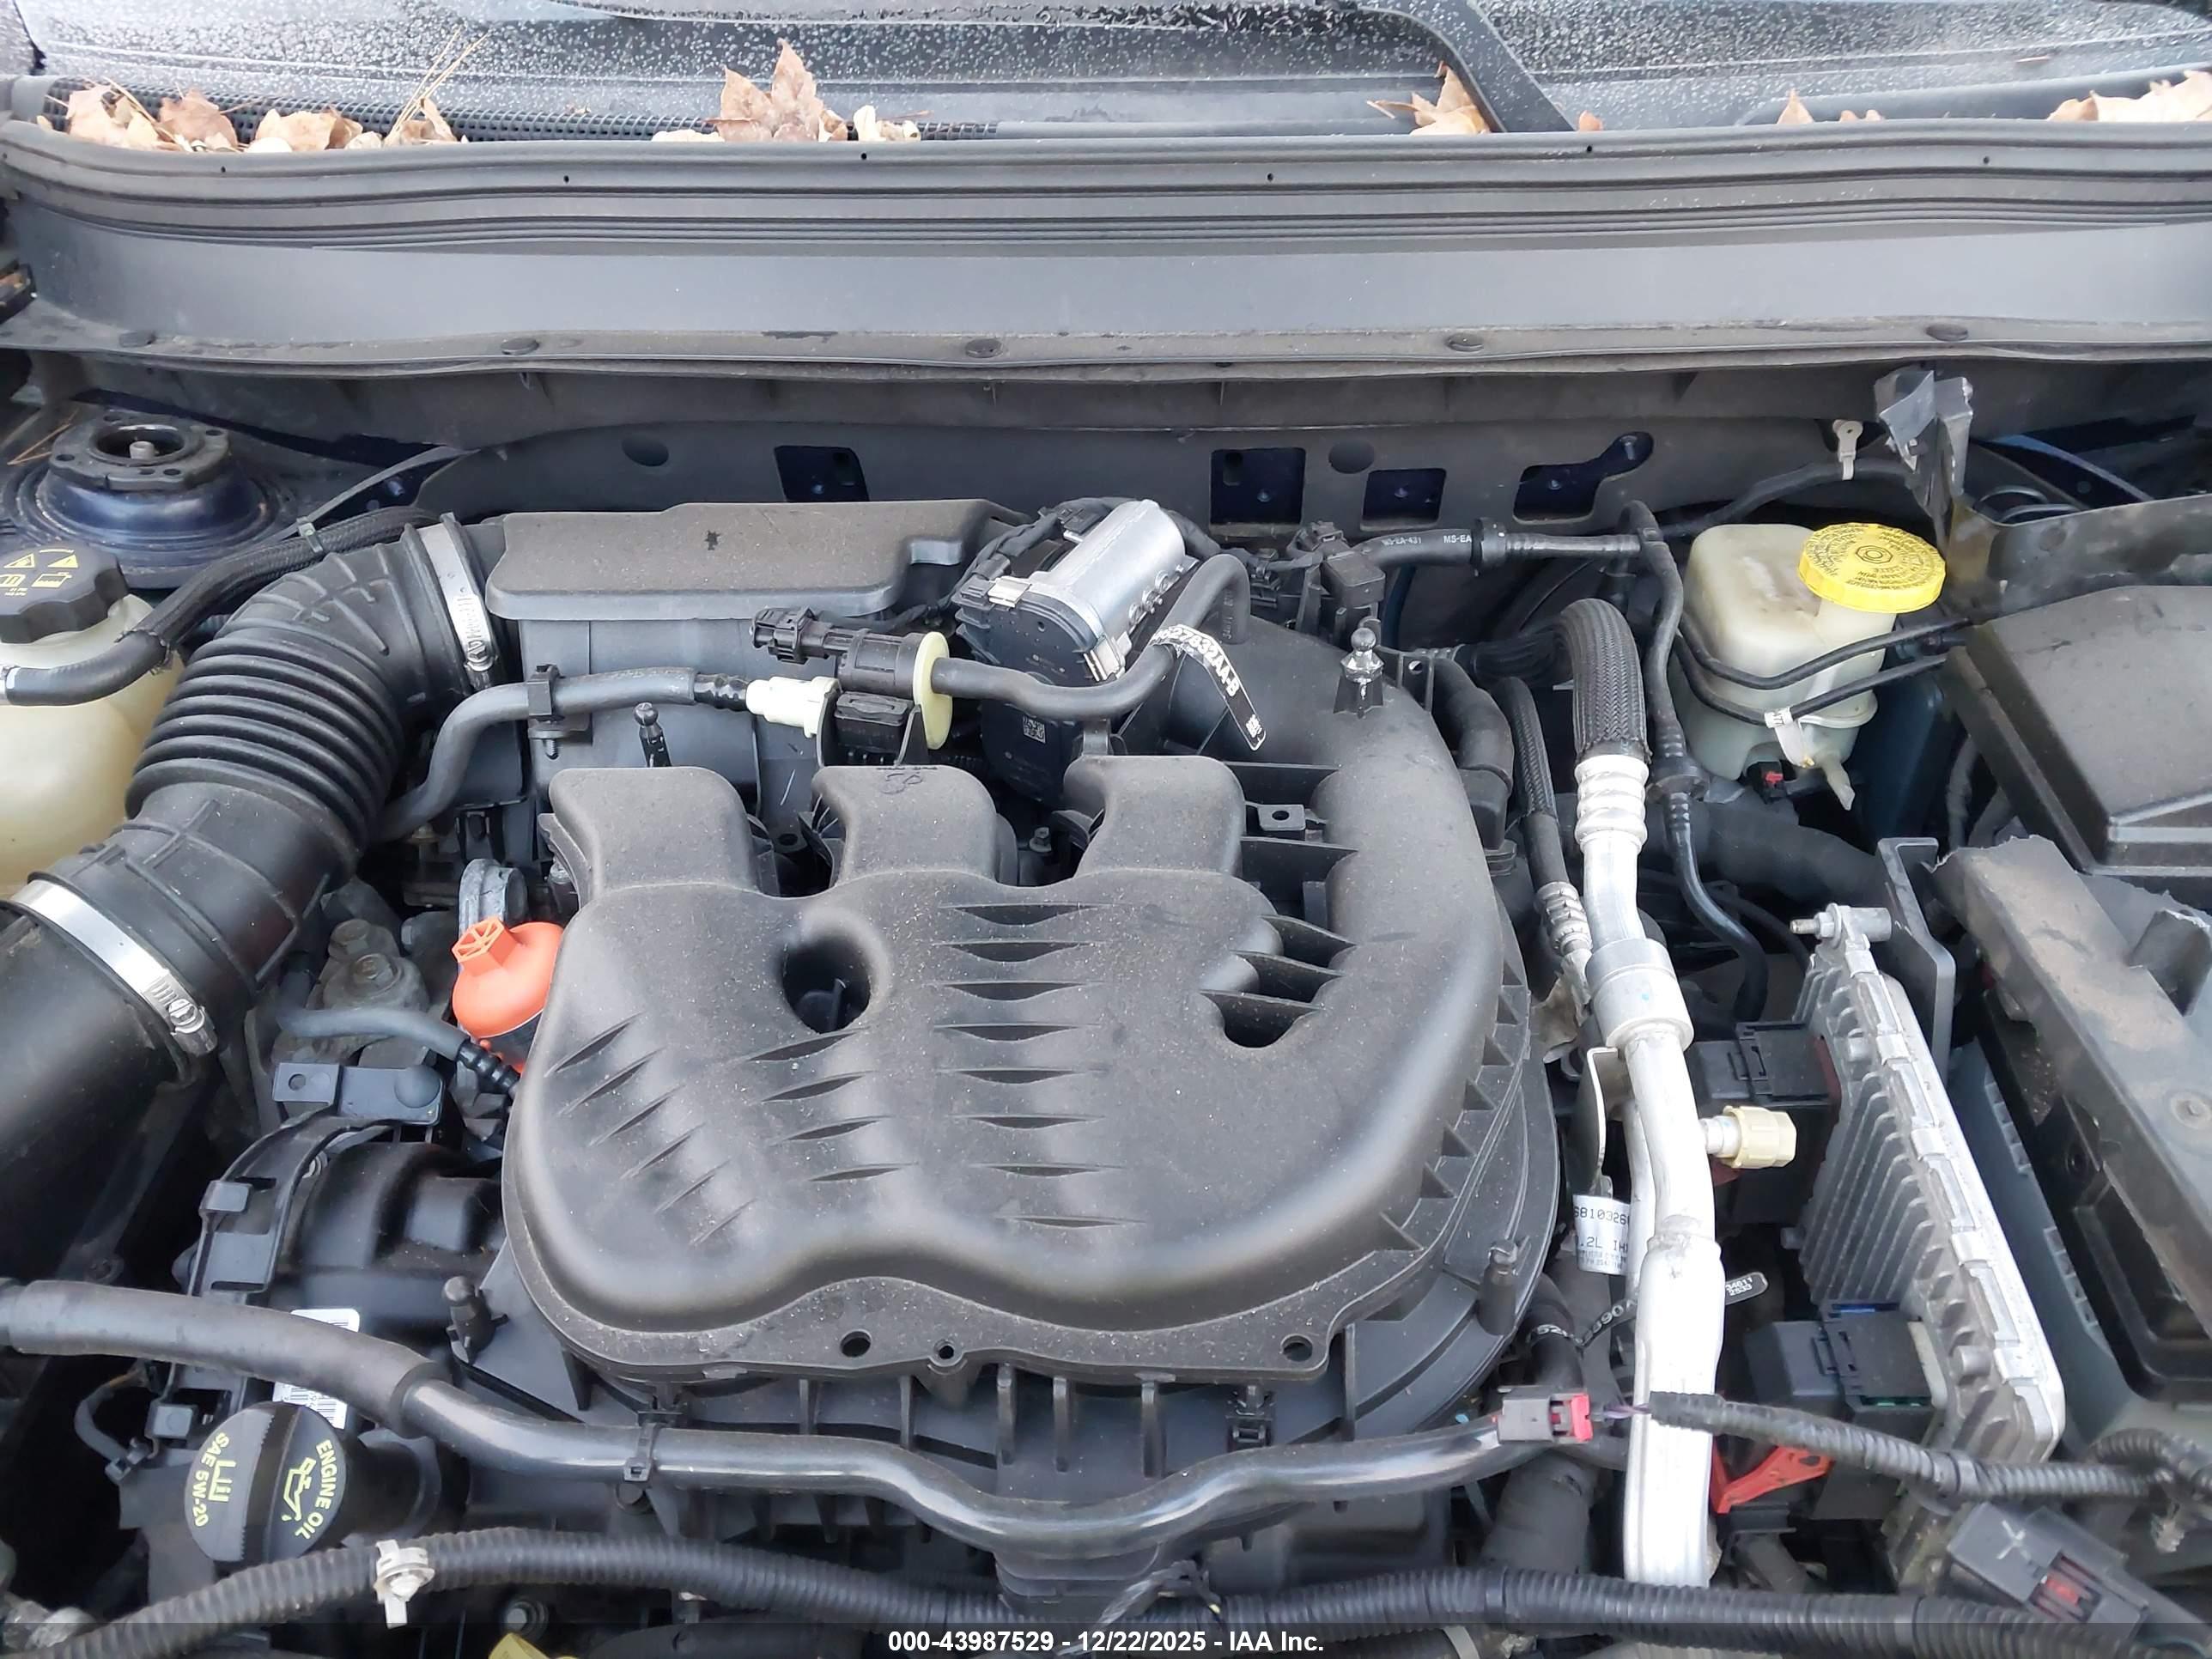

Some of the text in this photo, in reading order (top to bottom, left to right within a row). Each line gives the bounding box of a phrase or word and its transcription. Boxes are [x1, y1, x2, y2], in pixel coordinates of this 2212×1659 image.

[191, 1431, 230, 1528] SAE 5W-20
[295, 1438, 338, 1540] ENGINE OIL
